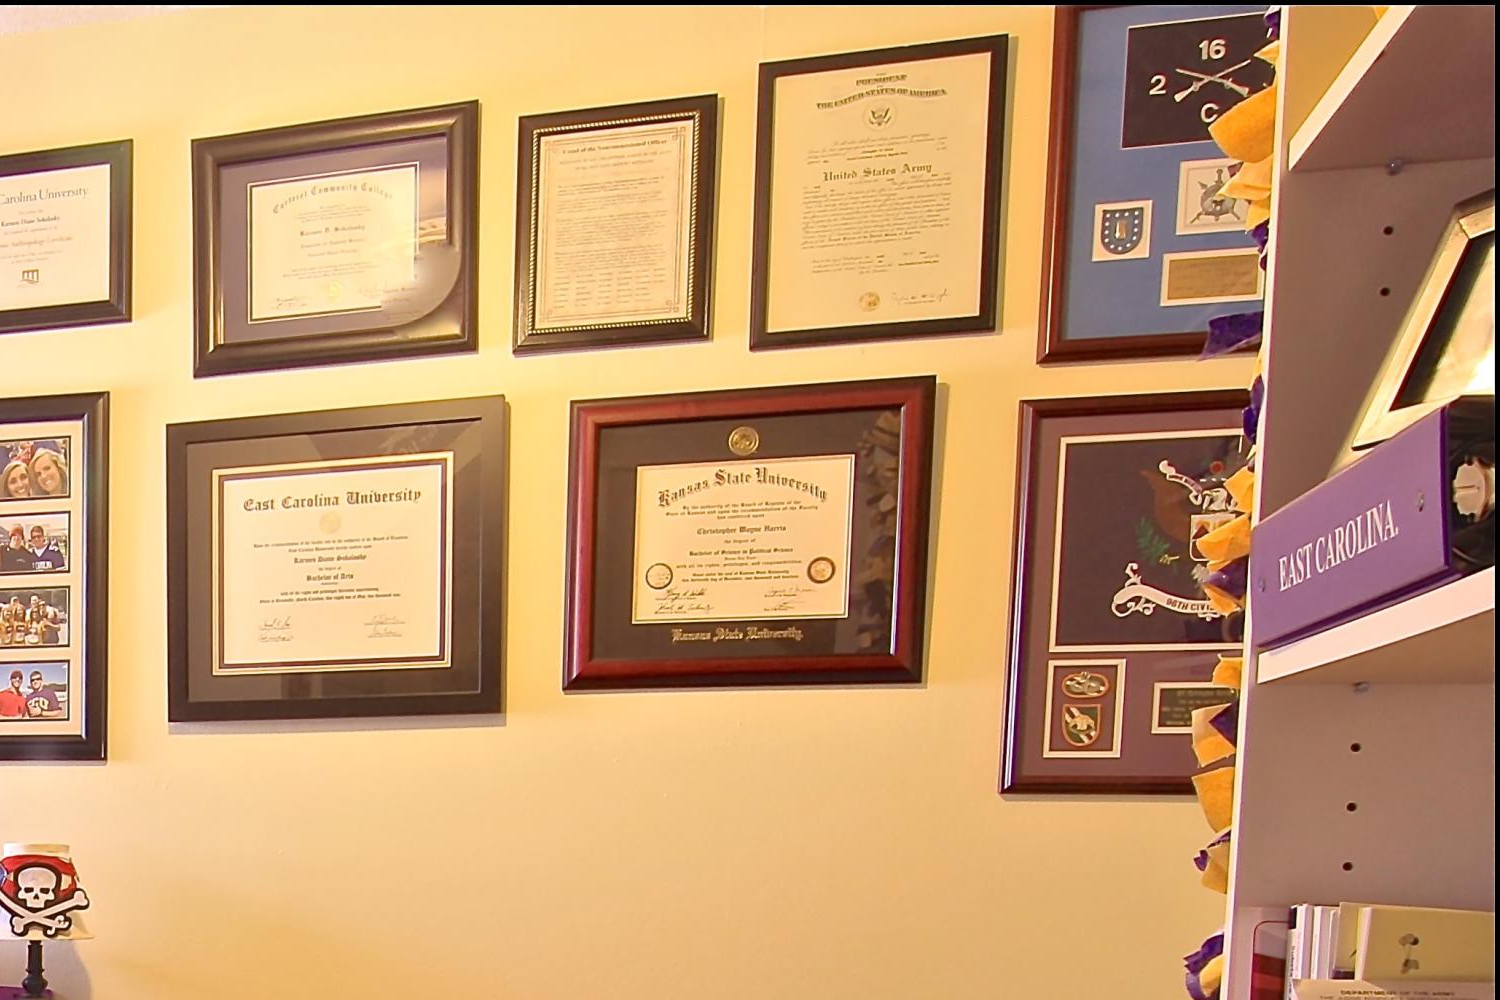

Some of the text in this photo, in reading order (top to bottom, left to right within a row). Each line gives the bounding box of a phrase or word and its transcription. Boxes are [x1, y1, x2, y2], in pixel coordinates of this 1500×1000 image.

[1199, 39, 1227, 60] 16
[1149, 75, 1167, 96] 2
[1200, 103, 1218, 123] C
[823, 163, 933, 182] United States Army
[38, 187, 88, 201] University
[658, 466, 828, 508] Kansas State University
[243, 488, 422, 512] East Carolina University
[1278, 541, 1313, 592] EAST
